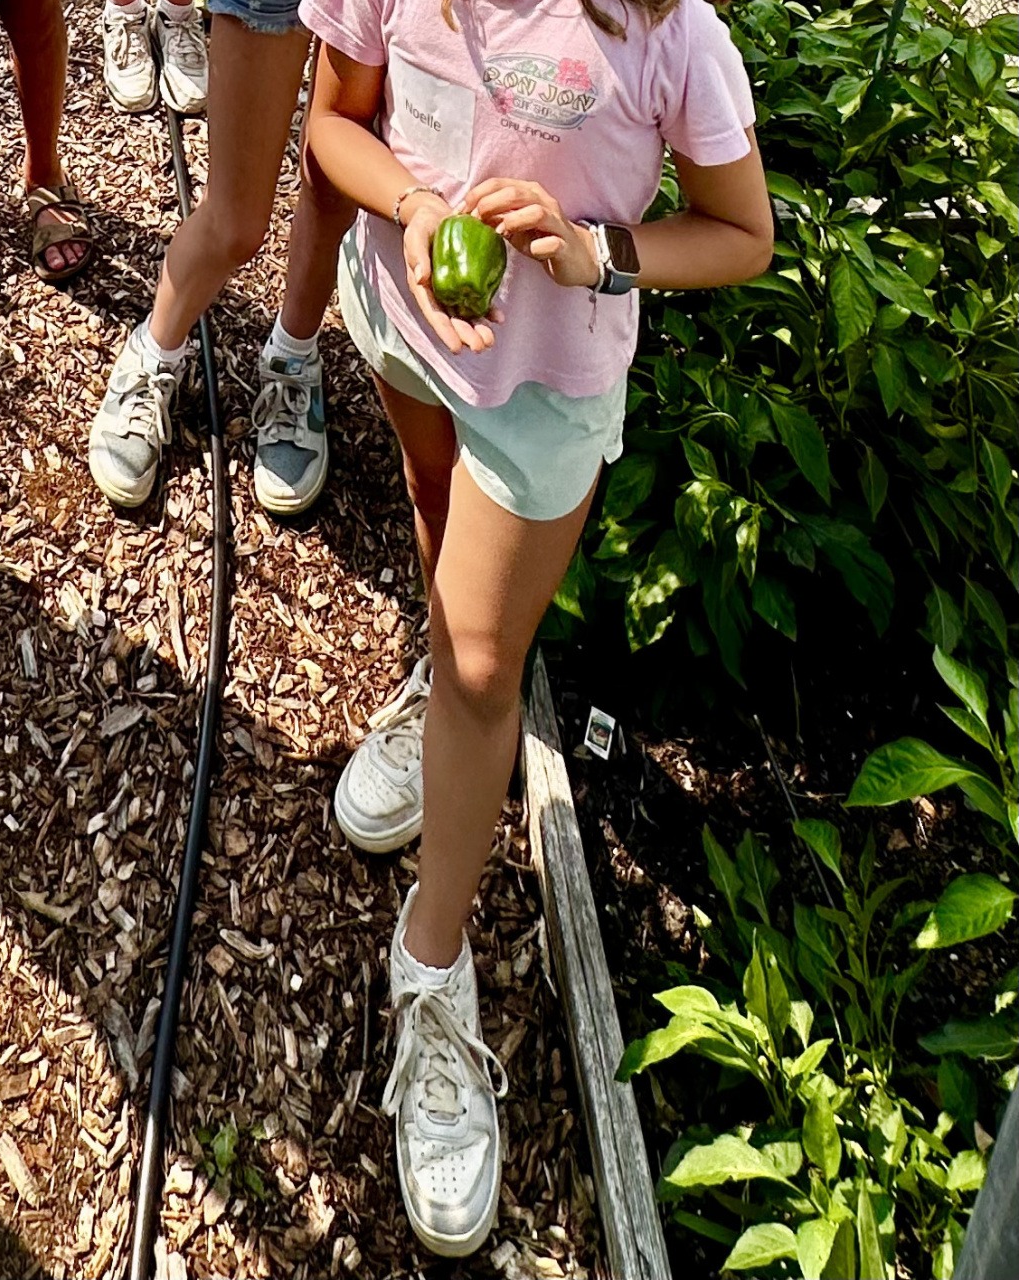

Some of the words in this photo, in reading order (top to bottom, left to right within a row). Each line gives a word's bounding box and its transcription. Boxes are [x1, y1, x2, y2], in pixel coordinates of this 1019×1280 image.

[482, 66, 537, 96] RON
[538, 83, 596, 113] JON
[405, 98, 442, 133] Noelle
